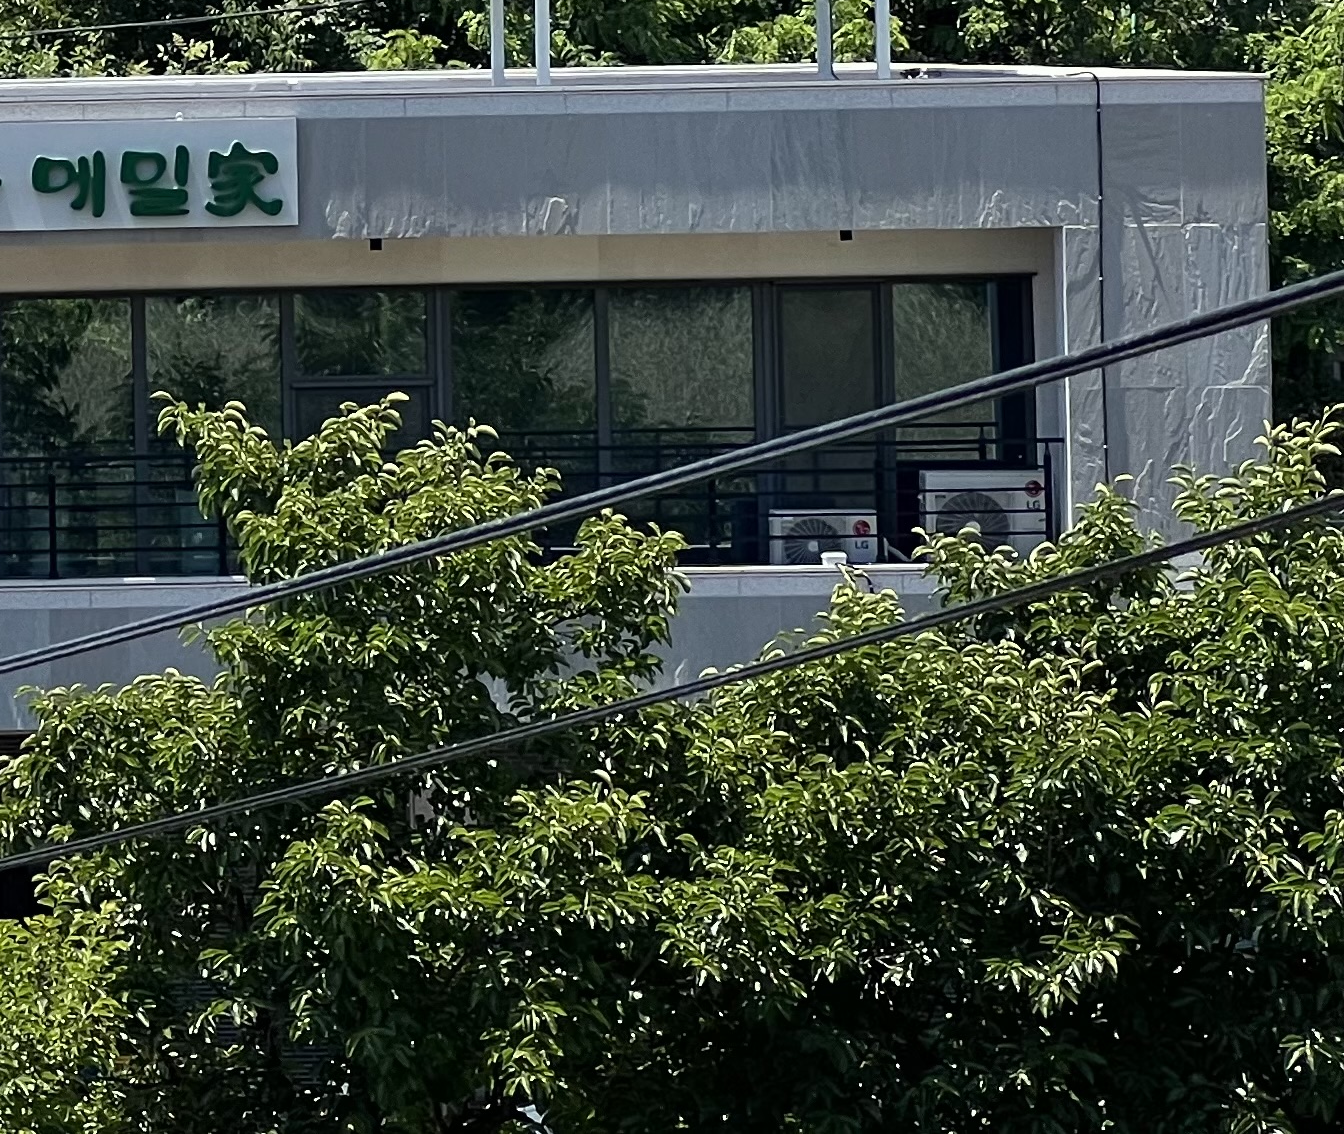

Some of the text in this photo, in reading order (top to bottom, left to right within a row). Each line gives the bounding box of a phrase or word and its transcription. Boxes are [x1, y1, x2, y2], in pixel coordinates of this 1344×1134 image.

[31, 140, 284, 218] 메밀家
[1026, 500, 1041, 510] LG
[854, 540, 869, 550] LG
